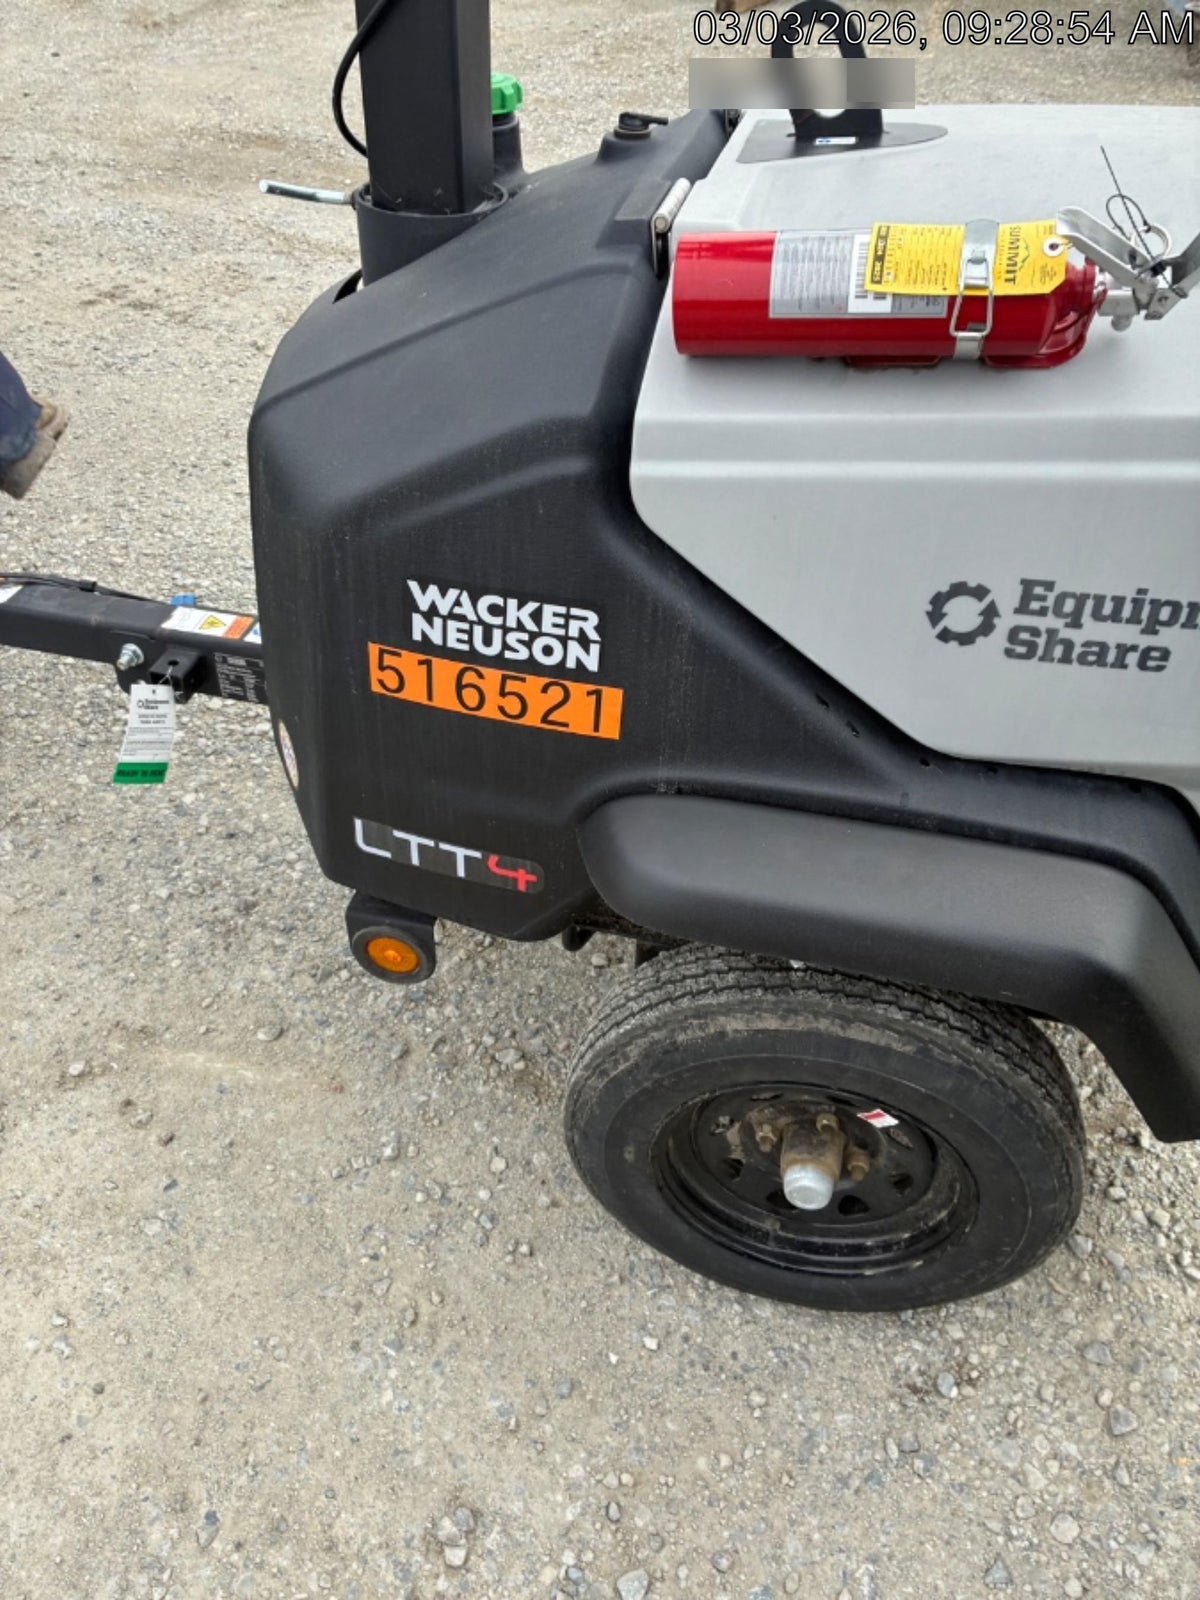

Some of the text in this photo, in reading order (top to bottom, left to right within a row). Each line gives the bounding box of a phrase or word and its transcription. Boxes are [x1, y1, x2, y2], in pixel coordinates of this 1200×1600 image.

[1004, 226, 1021, 285] SUMMIT
[406, 579, 602, 641] WACKER
[411, 612, 601, 672] NEUSON
[1004, 625, 1172, 672] Share
[376, 648, 603, 733] 516521
[353, 817, 538, 893] LTT4
